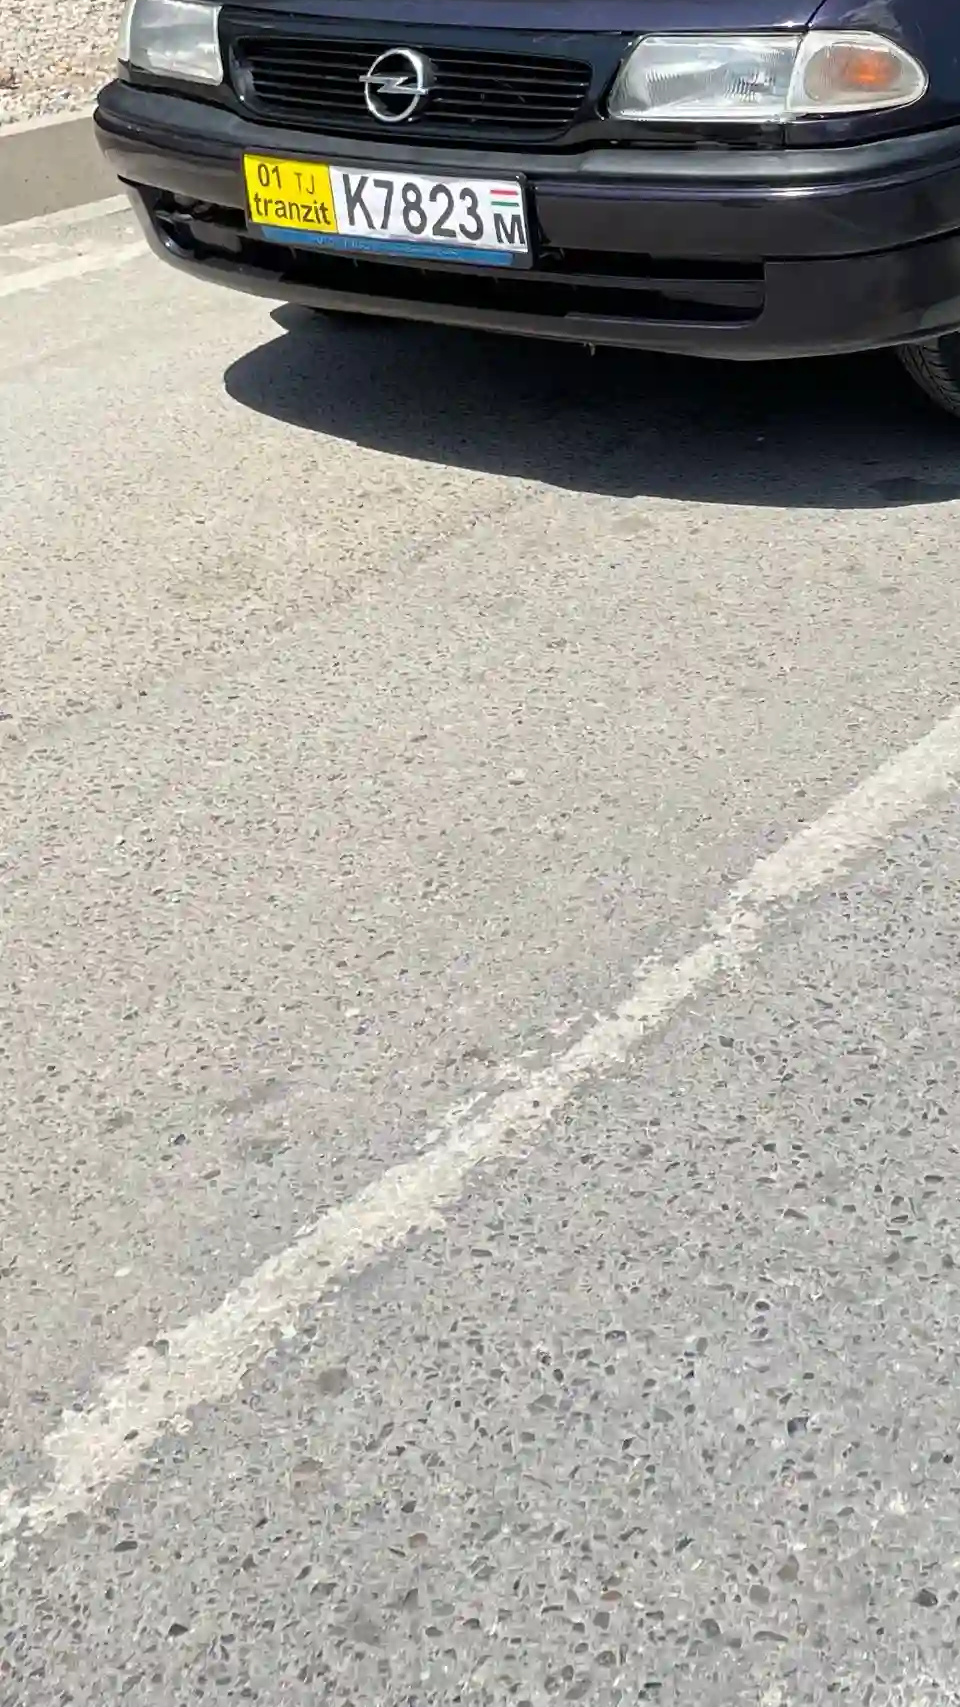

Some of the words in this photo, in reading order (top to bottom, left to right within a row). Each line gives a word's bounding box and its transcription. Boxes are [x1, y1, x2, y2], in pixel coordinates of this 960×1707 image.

[258, 163, 282, 188] 01
[294, 172, 316, 194] TJ
[253, 191, 332, 226] tranzit
[342, 173, 485, 241] K7823
[494, 212, 527, 245] M
